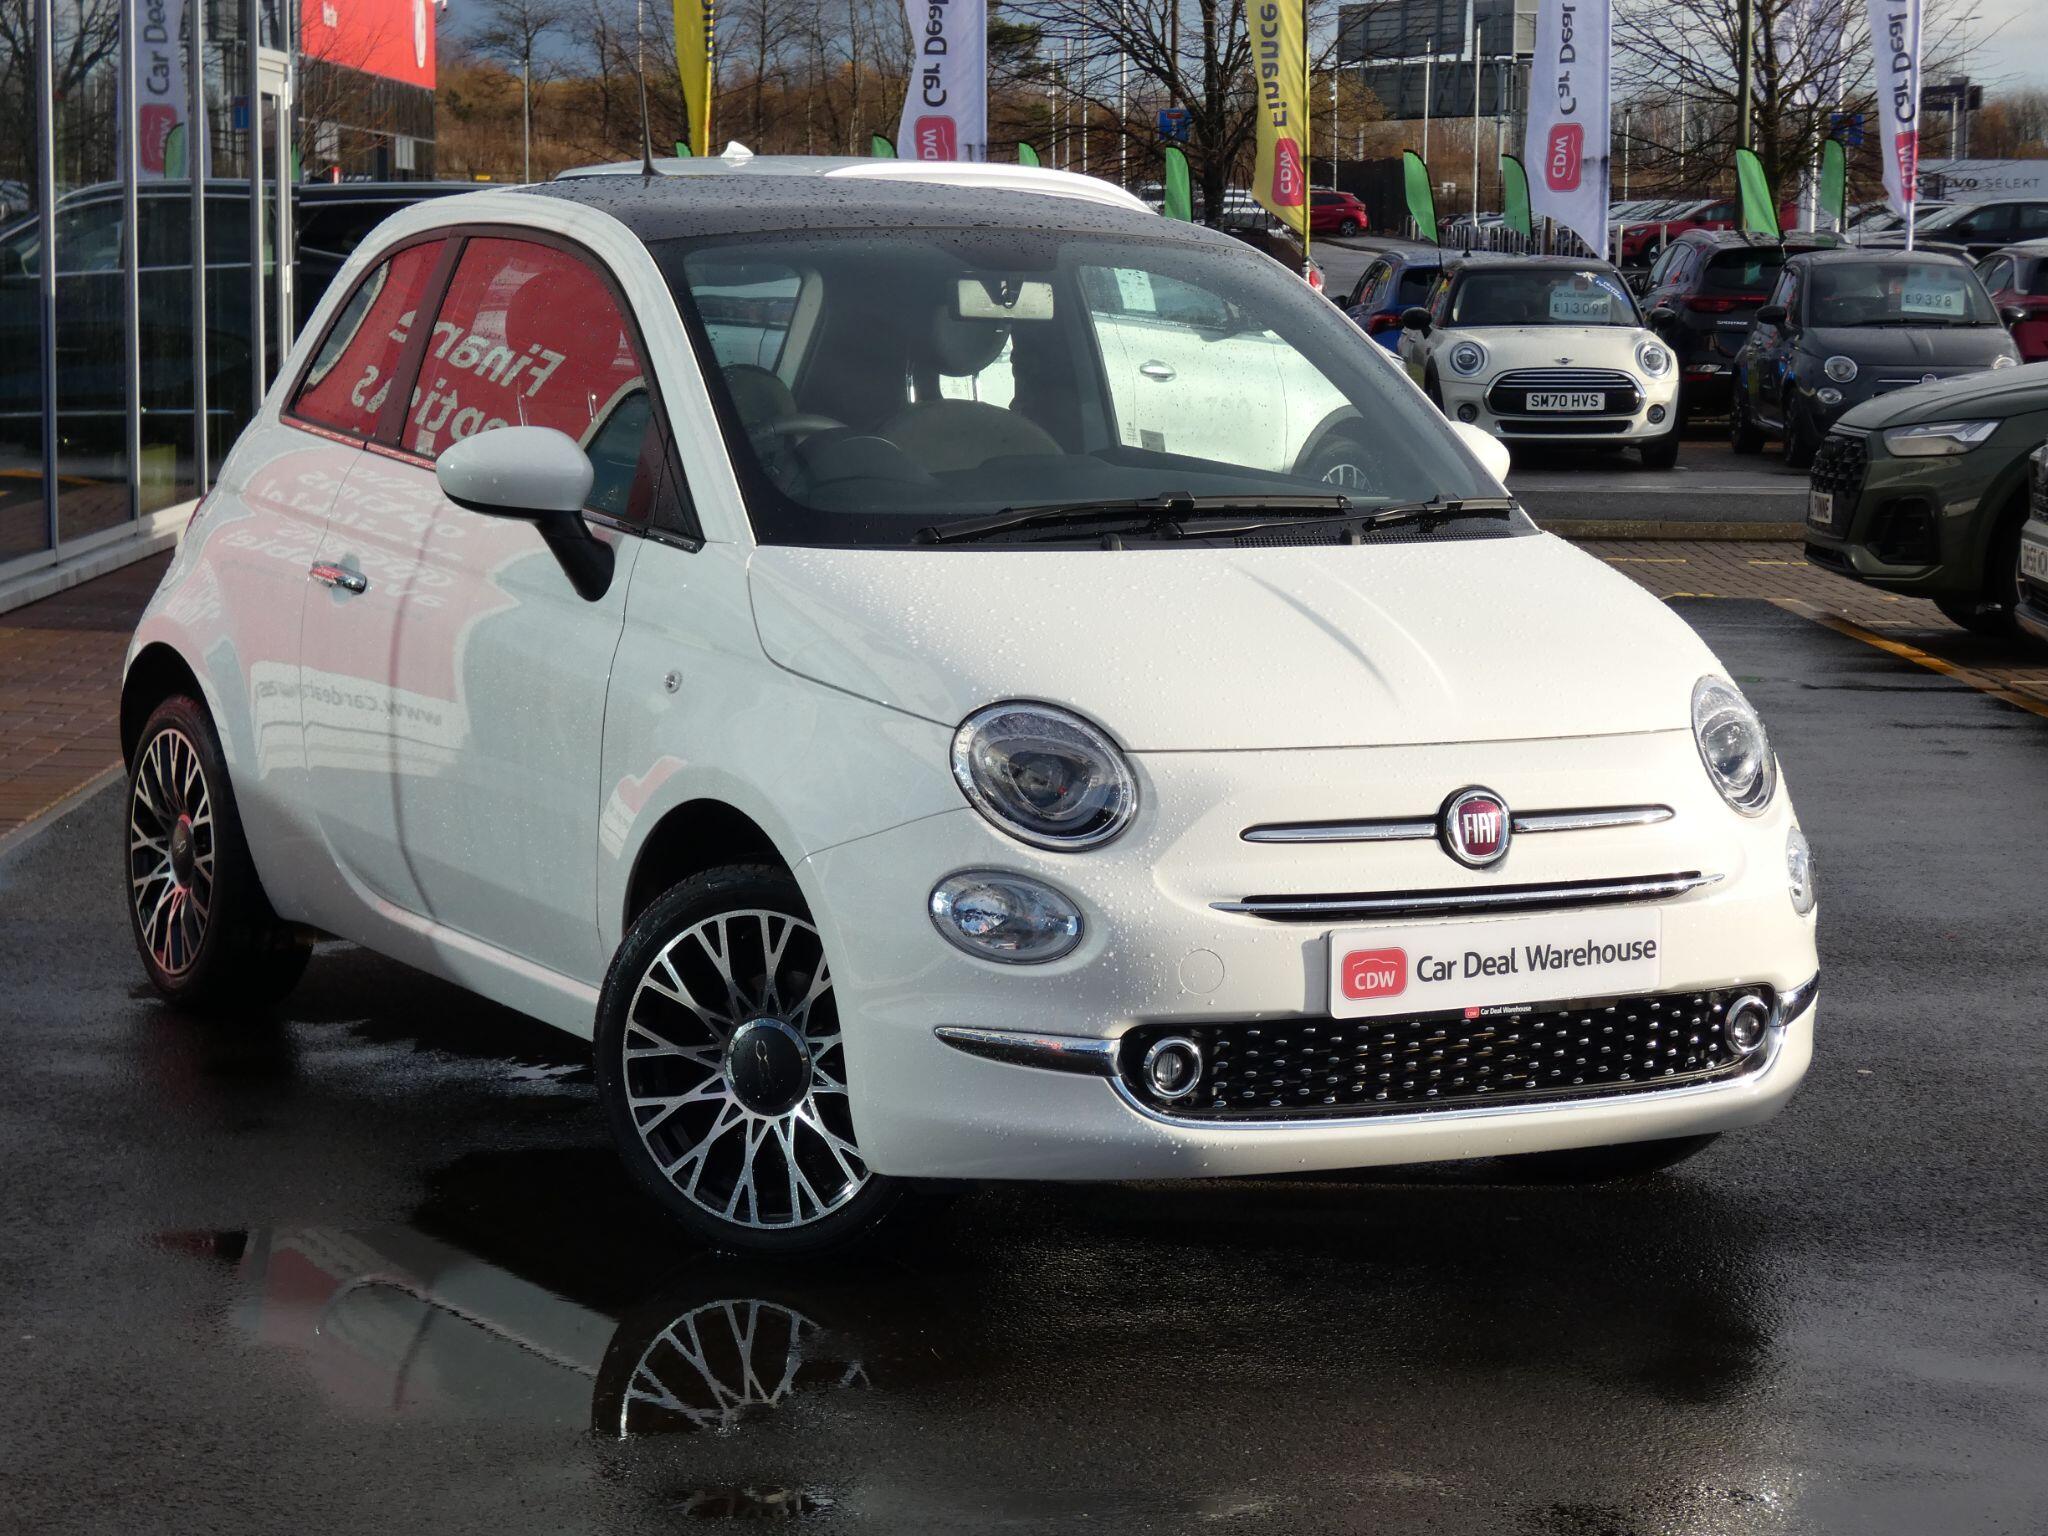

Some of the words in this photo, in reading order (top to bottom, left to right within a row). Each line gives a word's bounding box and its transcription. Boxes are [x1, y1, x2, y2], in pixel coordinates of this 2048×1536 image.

[146, 51, 170, 95] Car
[1985, 178, 2040, 189] SELEKT
[1531, 394, 1568, 407] SM70
[1571, 394, 1599, 407] HVS
[1463, 811, 1498, 845] FIAT
[1416, 955, 1457, 983] Car
[1463, 948, 1518, 979] Deal
[1525, 938, 1657, 972] Warehouse
[1354, 970, 1396, 991] CDW
[1503, 1004, 1532, 1013] Warehouse
